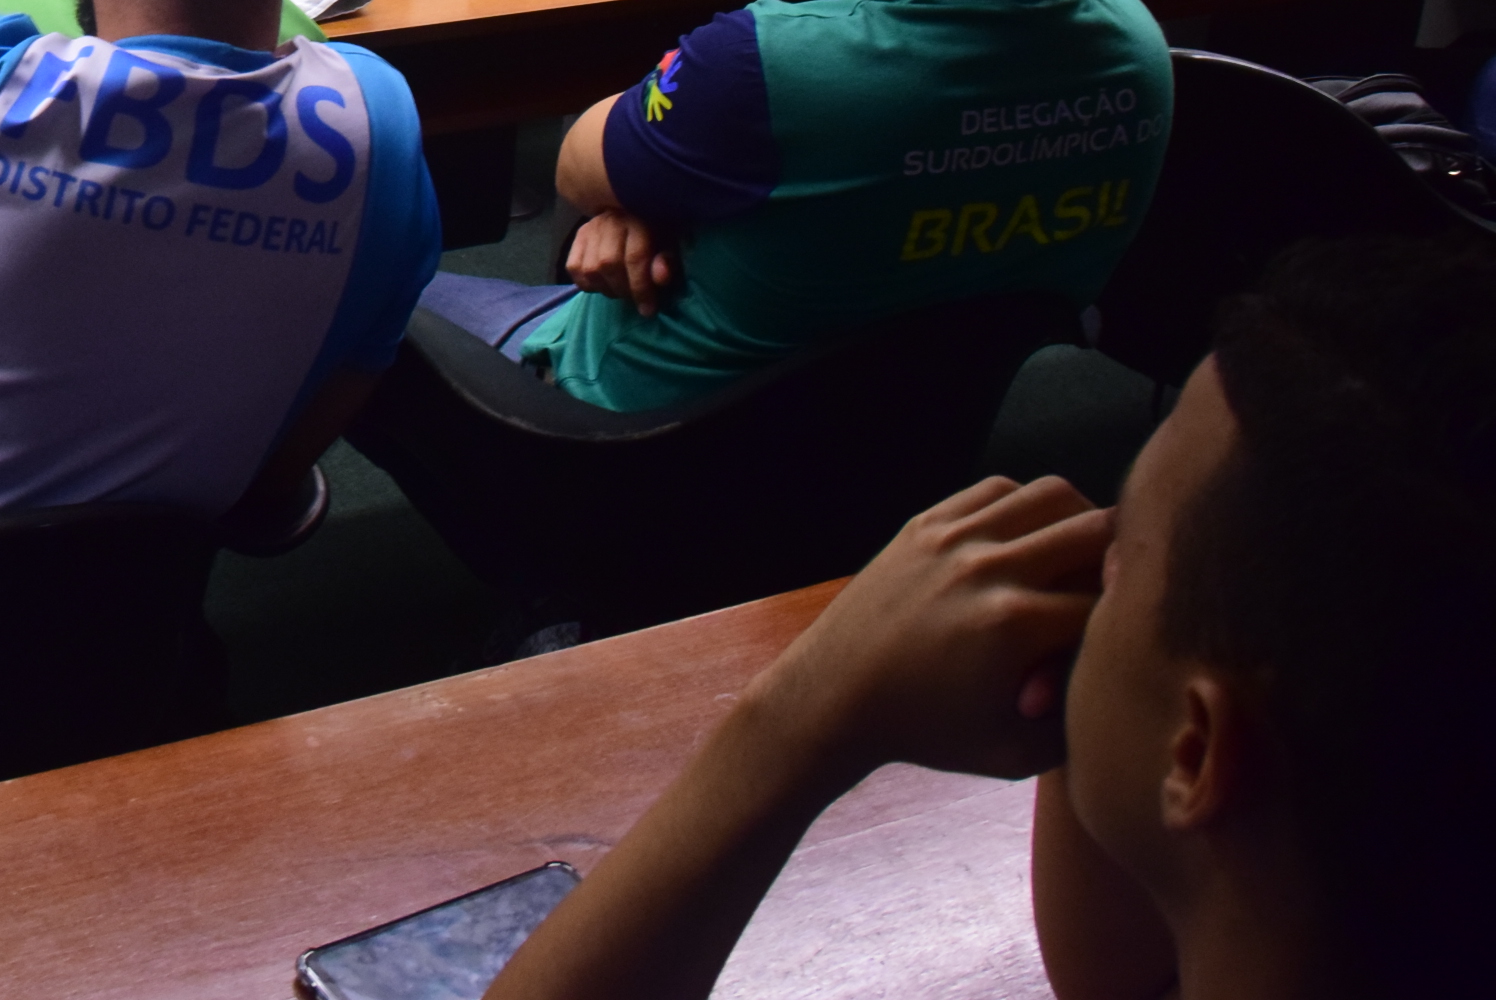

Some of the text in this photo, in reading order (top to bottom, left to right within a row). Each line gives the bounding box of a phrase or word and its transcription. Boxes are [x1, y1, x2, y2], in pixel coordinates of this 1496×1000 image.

[960, 87, 1138, 136] DELEGAÇÃO
[903, 124, 1130, 176] SURDOLÍMPICA
[185, 203, 343, 254] FEDERAL
[900, 178, 1132, 261] BRASIL
